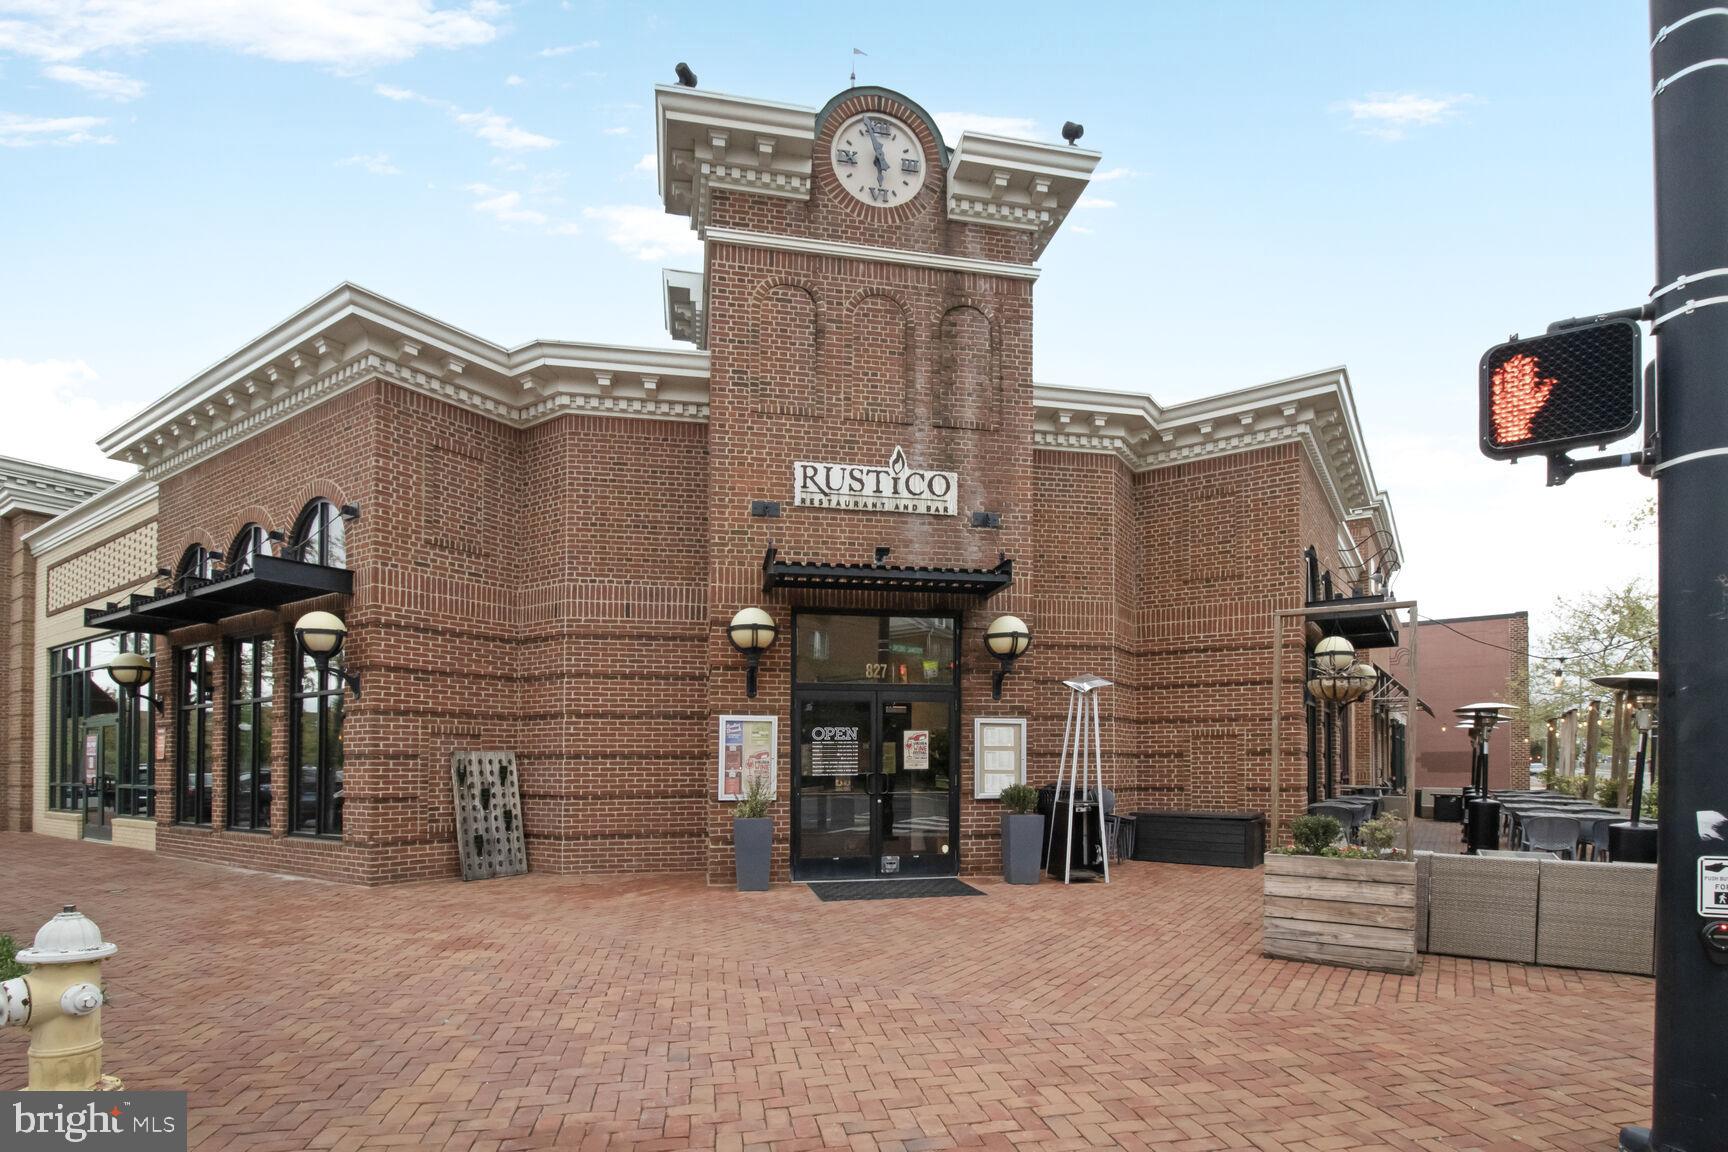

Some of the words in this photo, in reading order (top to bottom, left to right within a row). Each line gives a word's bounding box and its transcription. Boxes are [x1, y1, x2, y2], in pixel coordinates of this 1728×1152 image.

[901, 158, 919, 173] III
[869, 187, 889, 202] VI
[800, 497, 886, 510] RESTAURANT
[894, 502, 918, 512] AND
[926, 505, 949, 514] BAR
[865, 663, 888, 679] 827
[811, 726, 859, 741] OPEN
